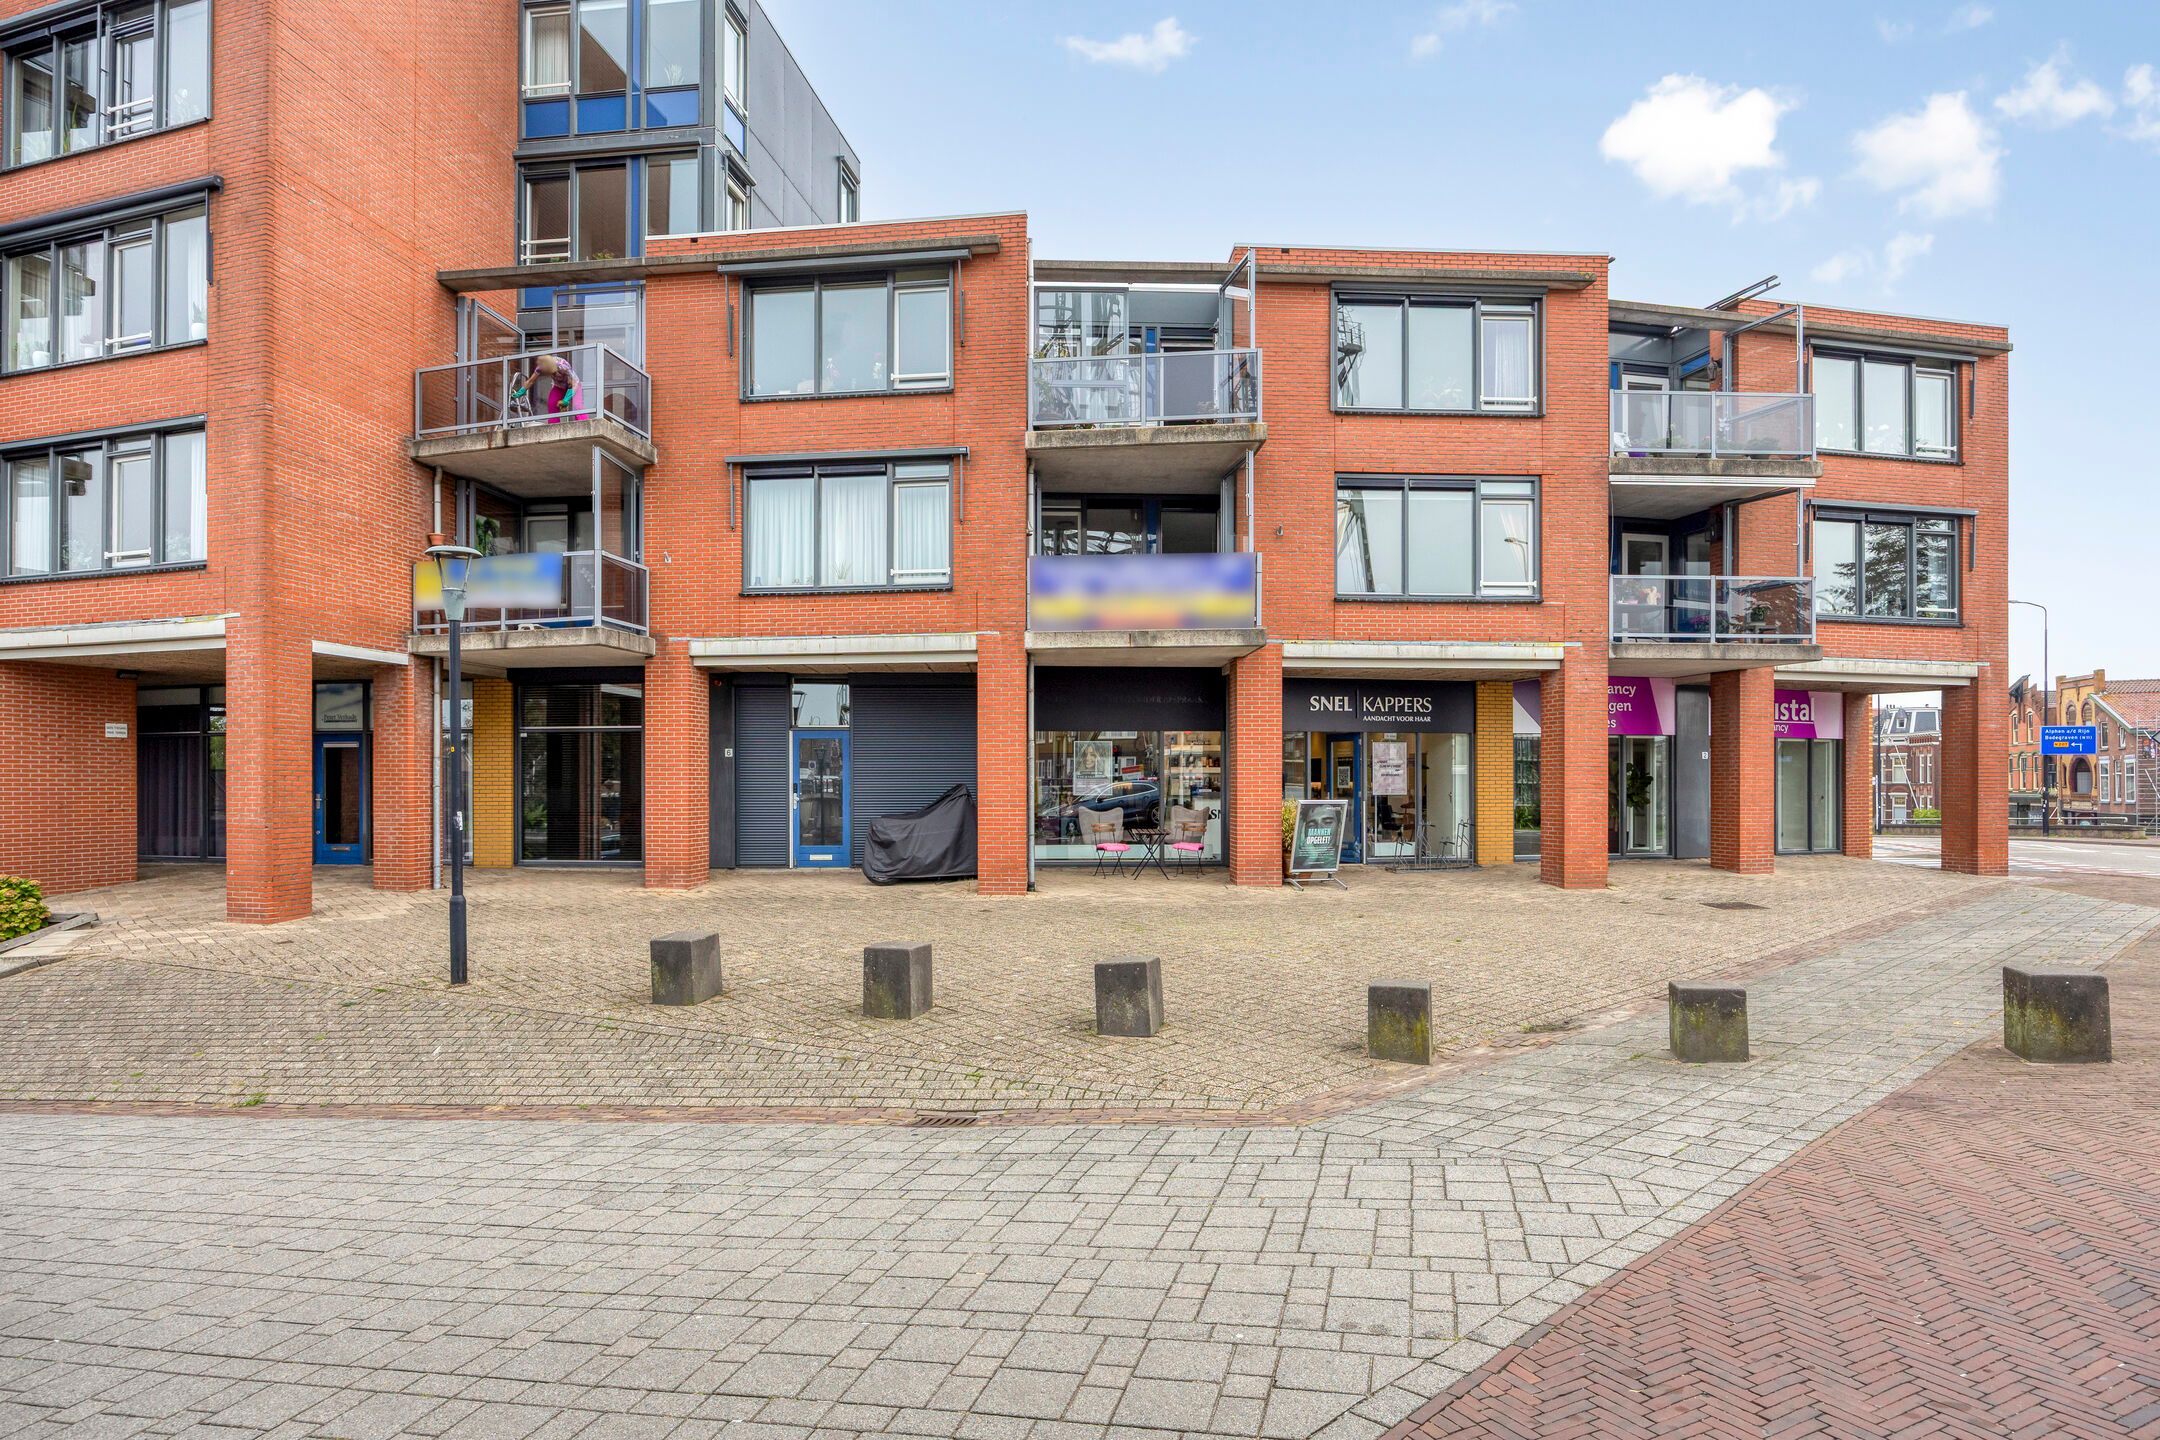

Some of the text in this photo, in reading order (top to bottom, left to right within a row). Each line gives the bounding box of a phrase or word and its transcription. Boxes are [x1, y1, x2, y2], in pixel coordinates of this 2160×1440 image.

[1310, 696, 1432, 712] SNEL KAPPERS
[1608, 702, 1632, 714] gen
[1306, 836, 1331, 845] OPGELET!
